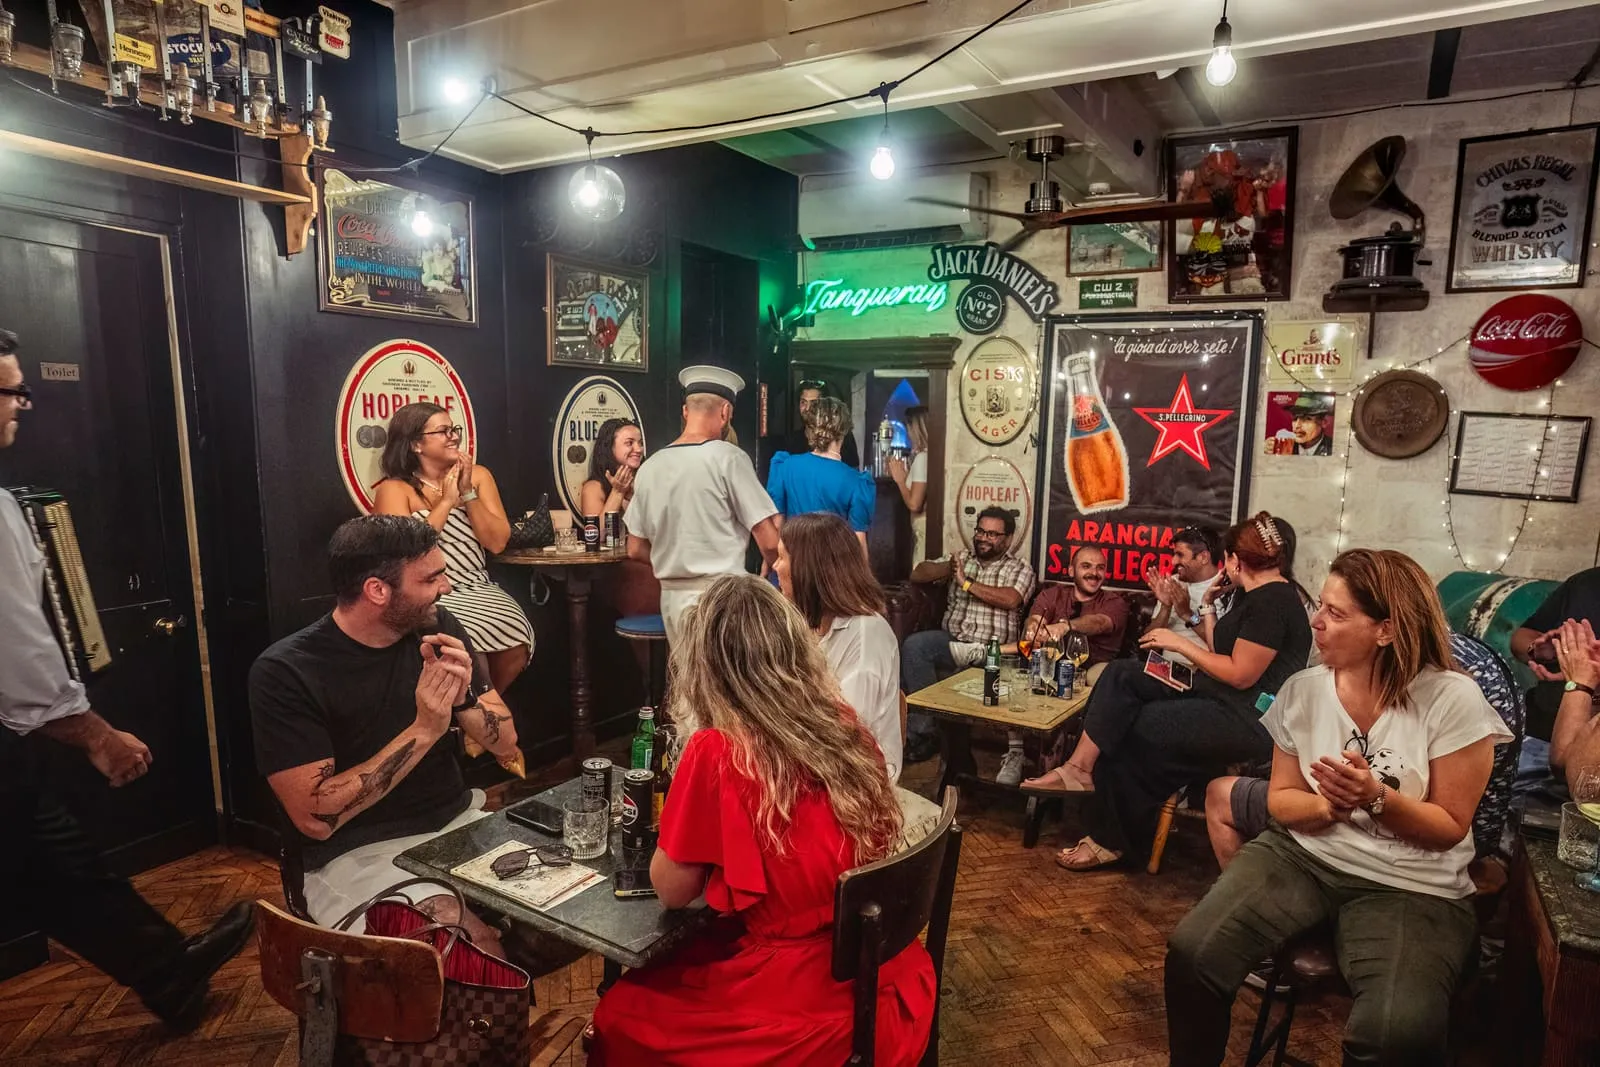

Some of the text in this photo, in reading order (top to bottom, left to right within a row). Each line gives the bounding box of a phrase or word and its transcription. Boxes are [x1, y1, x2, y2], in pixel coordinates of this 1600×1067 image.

[119, 43, 152, 61] Hennessy
[1476, 154, 1577, 187] CHIVAS REGAL
[1471, 223, 1568, 242] BLENDED SCOTCH
[1471, 240, 1565, 263] WHISKY
[930, 246, 1055, 316] JACK DANIEL'S
[805, 278, 948, 317] Tanqueray
[977, 290, 992, 300] OLD
[1113, 335, 1125, 354] la
[1168, 339, 1201, 354] aver
[45, 366, 77, 377] Toilet
[969, 366, 1024, 383] CISK
[973, 417, 1019, 437] LAGER
[1158, 412, 1207, 423] S.PELLEGRINO
[569, 420, 599, 442] BLUE
[966, 485, 1021, 503] HOPLEAF
